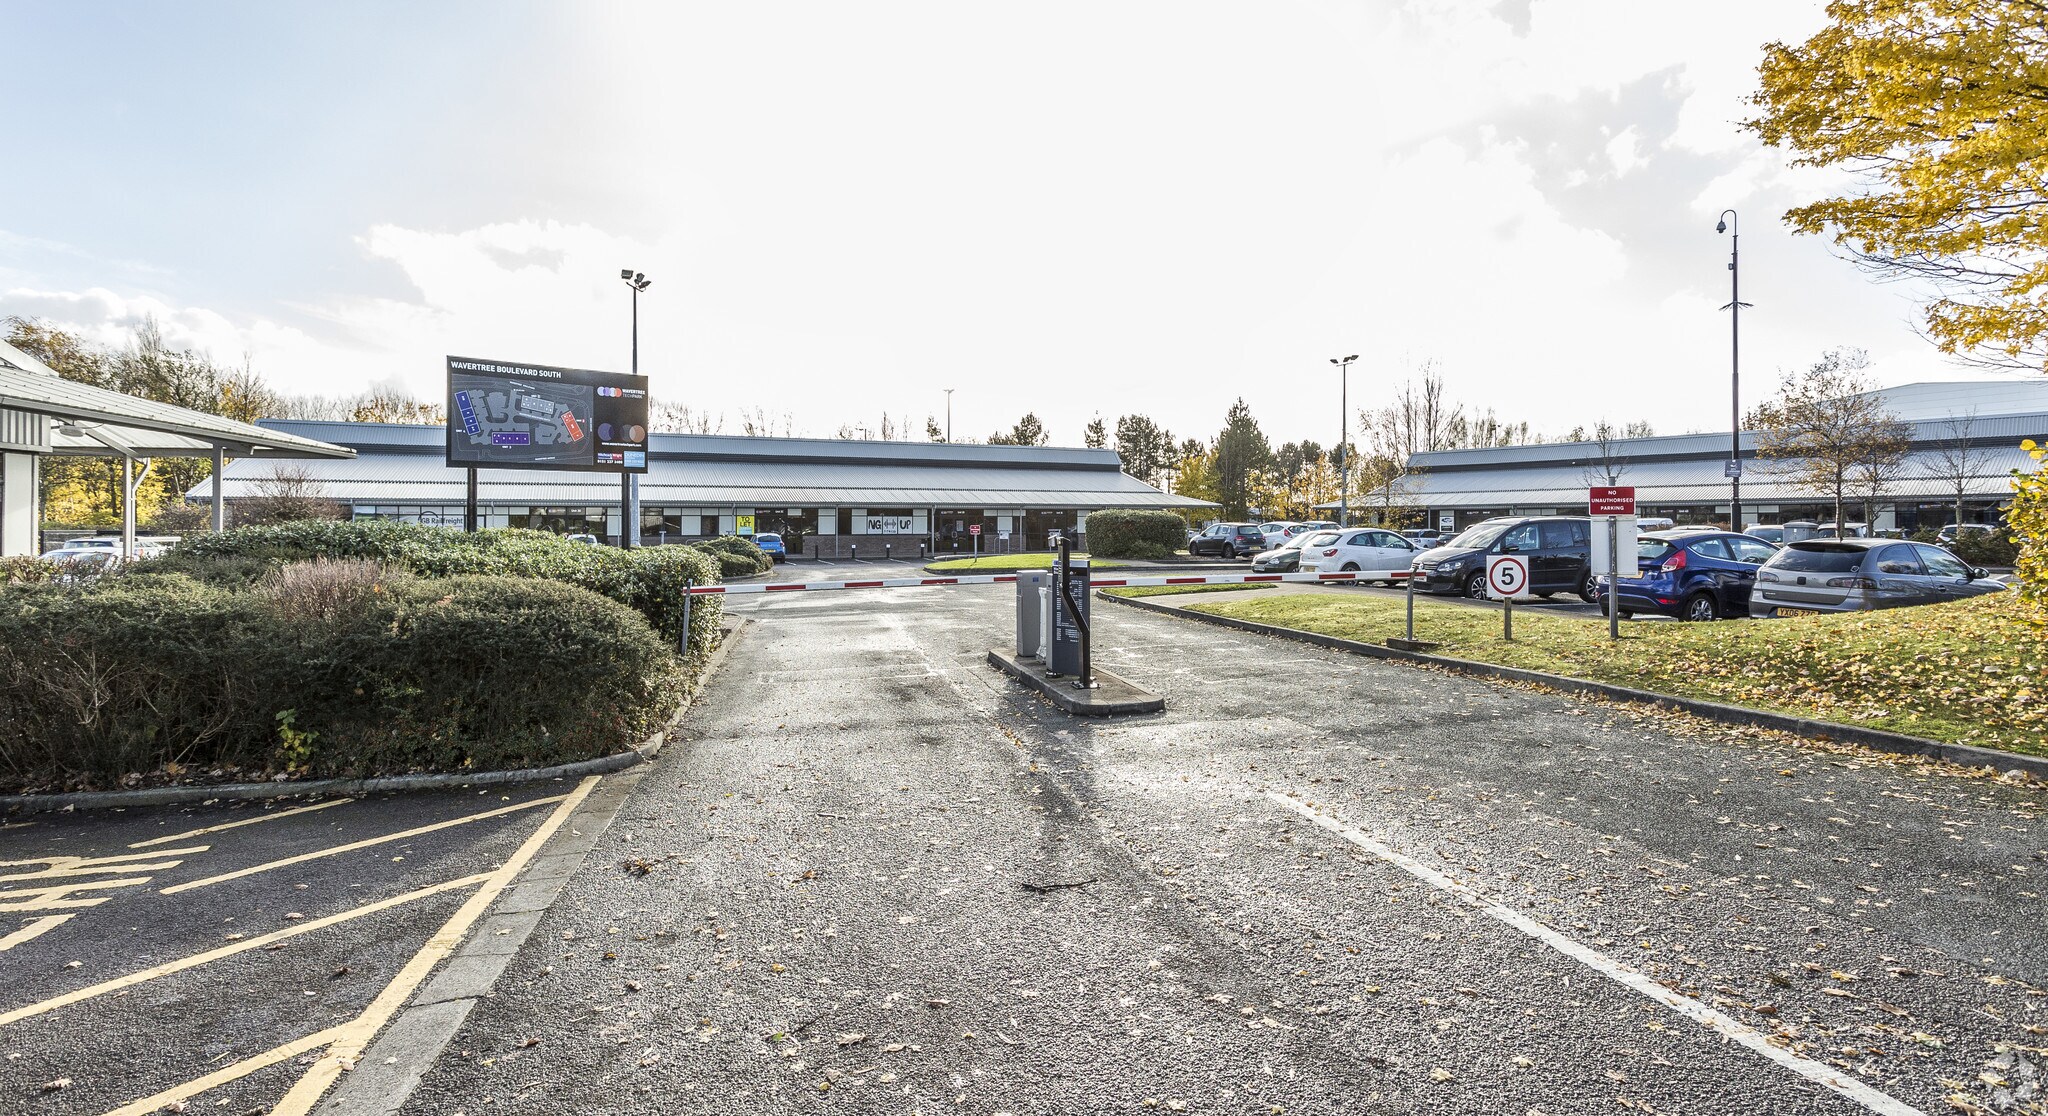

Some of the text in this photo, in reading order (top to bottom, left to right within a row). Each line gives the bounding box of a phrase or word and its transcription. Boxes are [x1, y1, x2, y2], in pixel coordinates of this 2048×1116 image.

[450, 361, 562, 378] WAVERTREE BOULEVARD SOUTH
[900, 519, 911, 530] UP
[1501, 567, 1515, 586] 5
